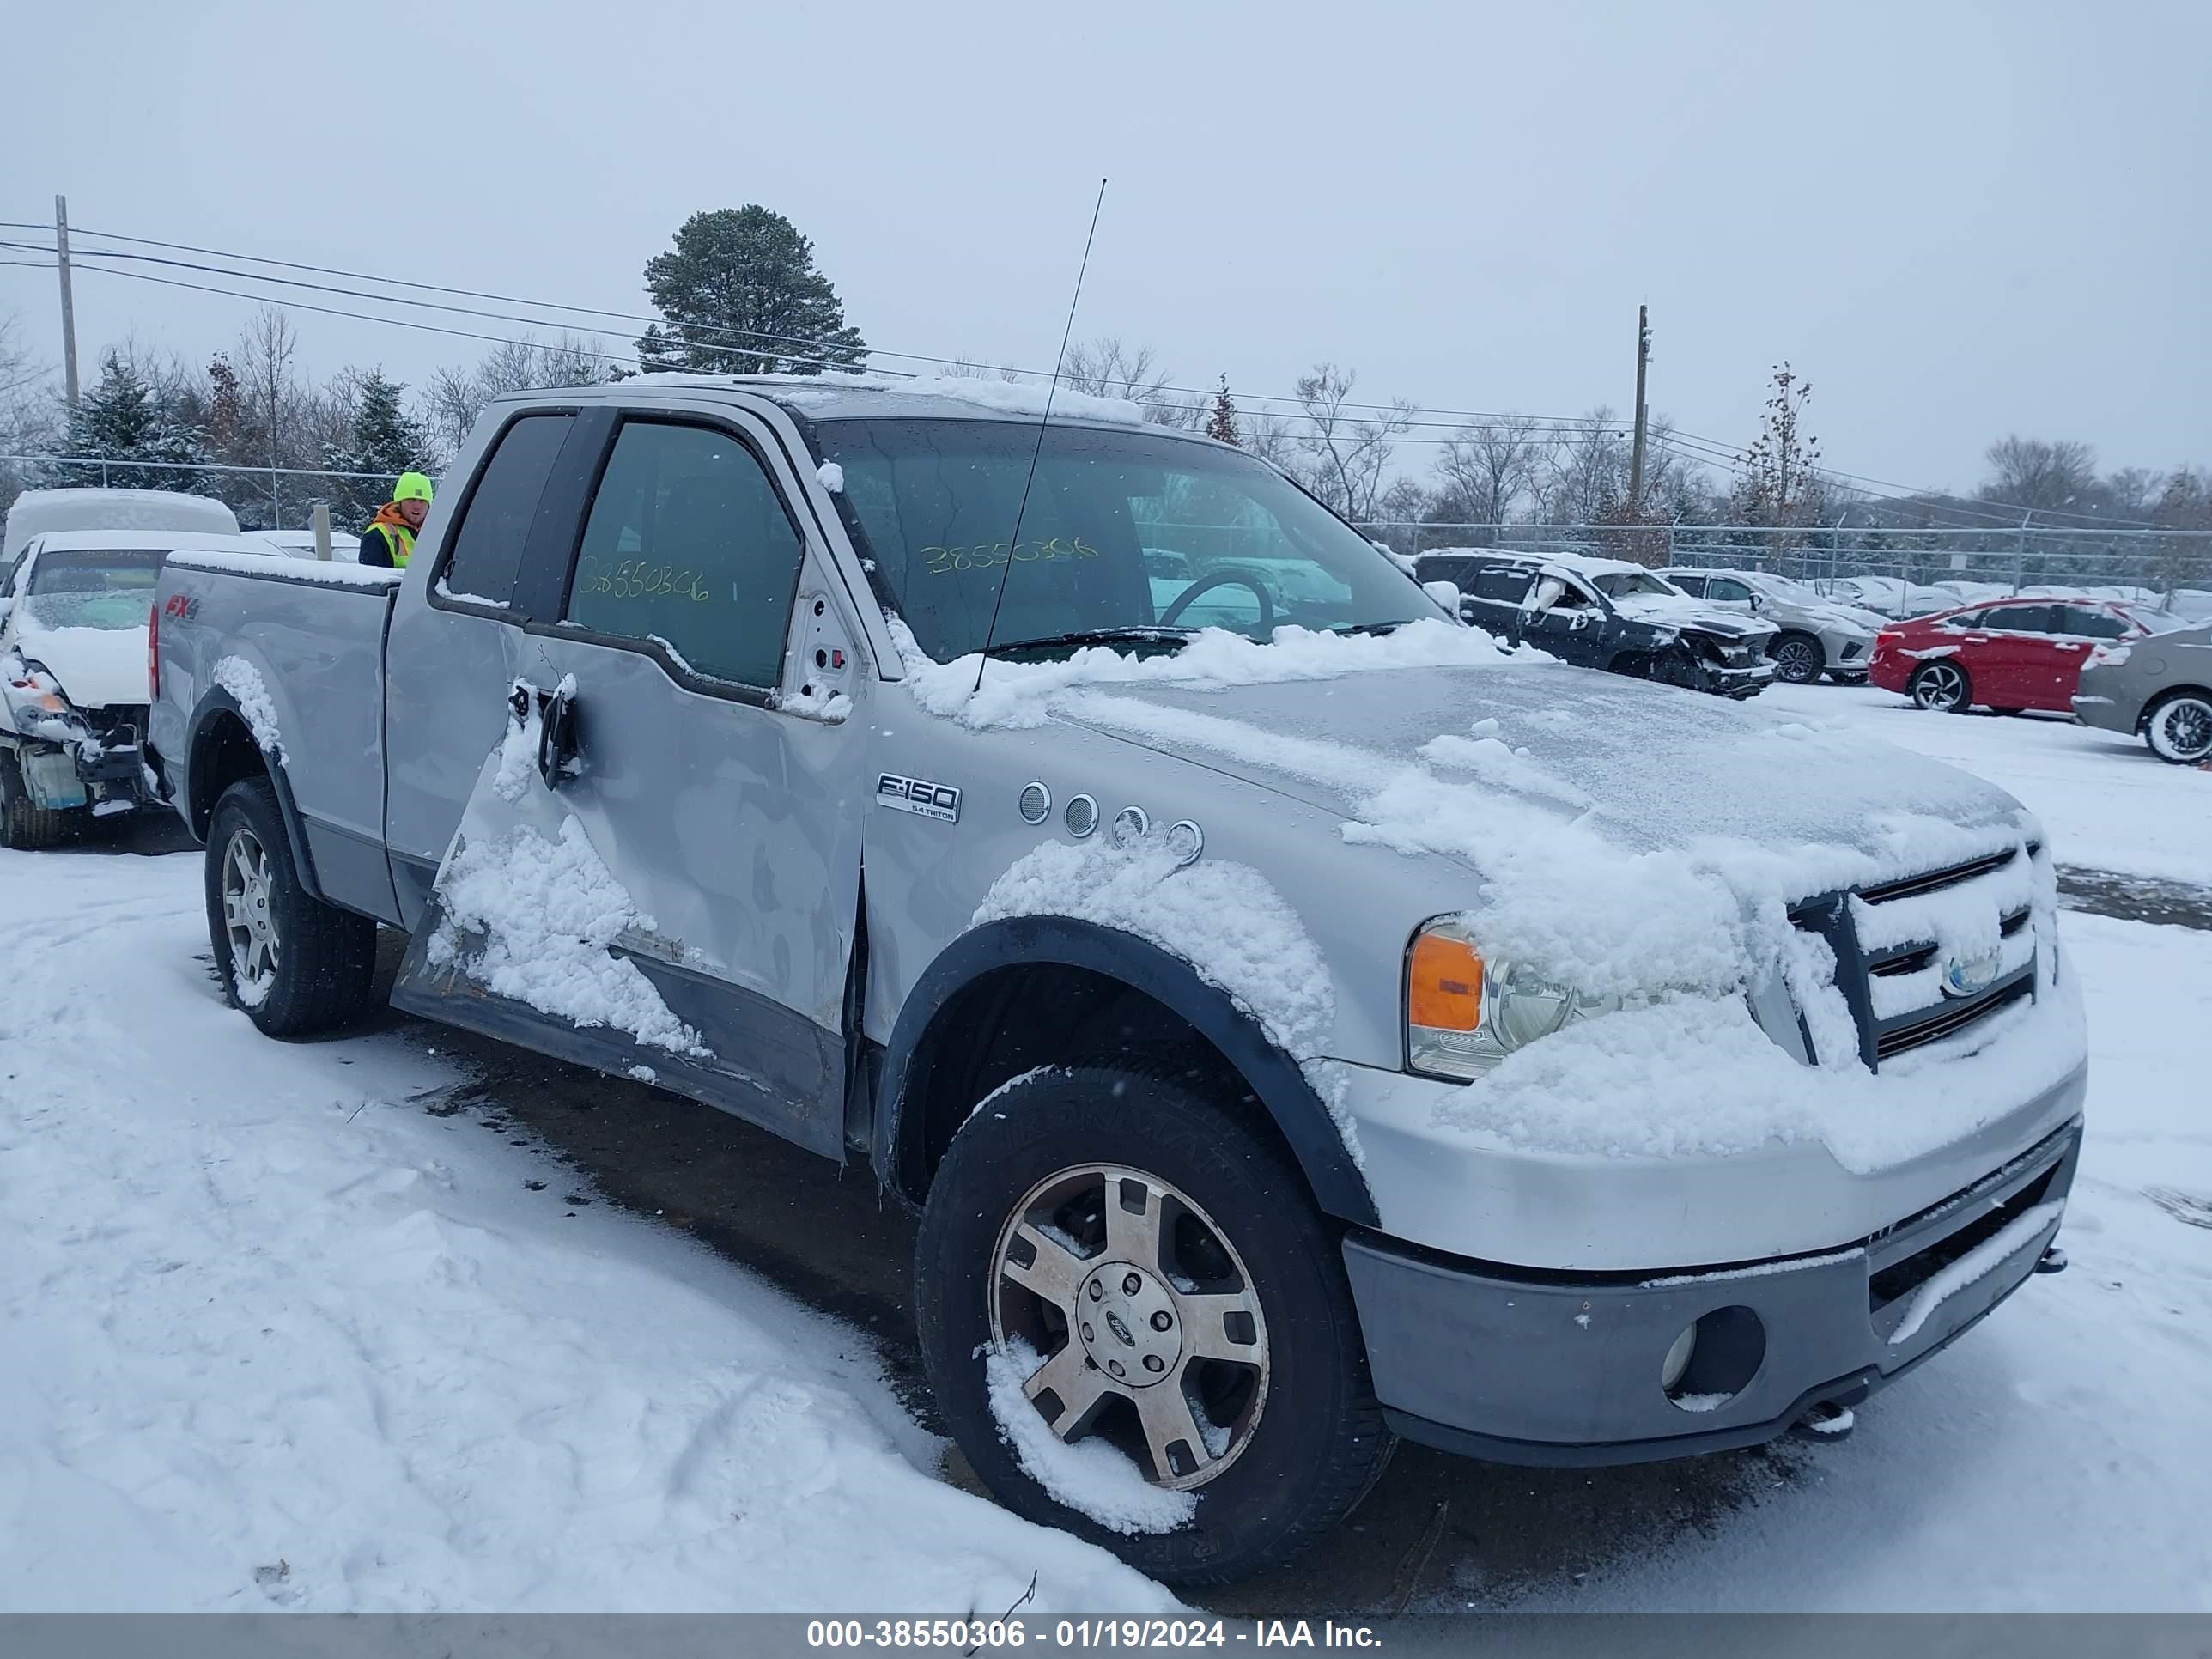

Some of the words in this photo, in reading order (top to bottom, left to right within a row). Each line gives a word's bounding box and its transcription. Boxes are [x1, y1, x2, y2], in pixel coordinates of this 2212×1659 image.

[920, 536, 1100, 574] 38550306
[578, 555, 709, 601] 38550306
[164, 594, 200, 620] FX4
[878, 775, 957, 810] F-150
[925, 808, 955, 821] TRITON
